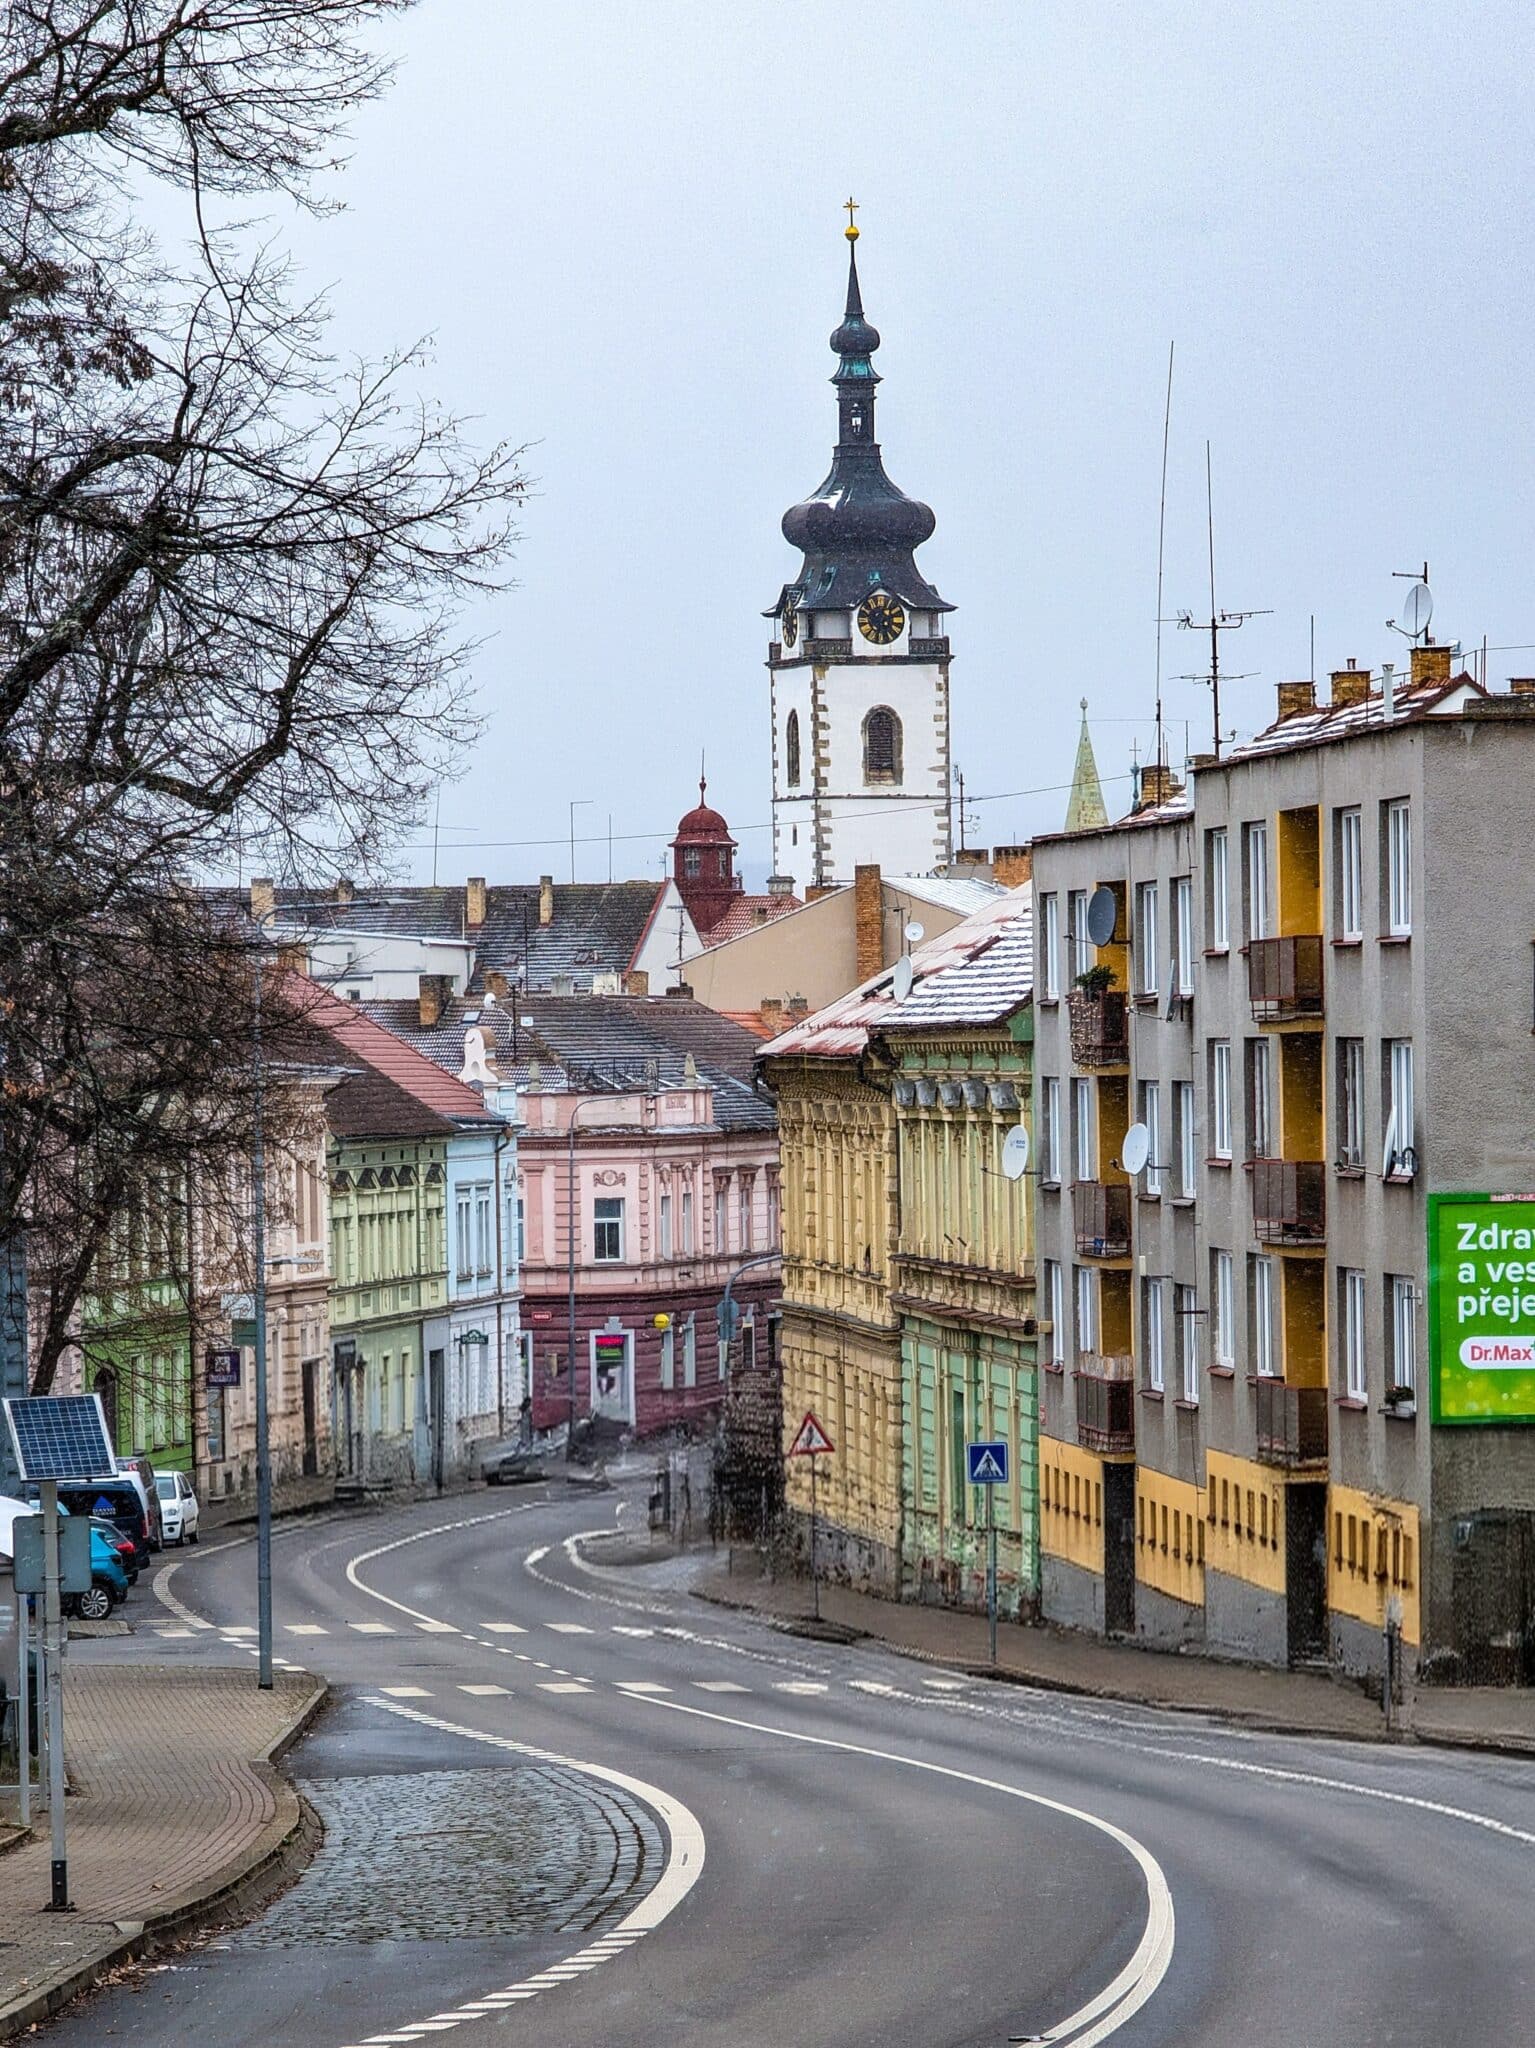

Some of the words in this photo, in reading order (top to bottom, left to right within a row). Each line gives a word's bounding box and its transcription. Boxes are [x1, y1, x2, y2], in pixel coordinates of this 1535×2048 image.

[1456, 1222, 1535, 1250] Zdra
[1457, 1262, 1476, 1284] a
[1457, 1286, 1535, 1324] přeje
[1470, 1345, 1532, 1361] Dr.Max
